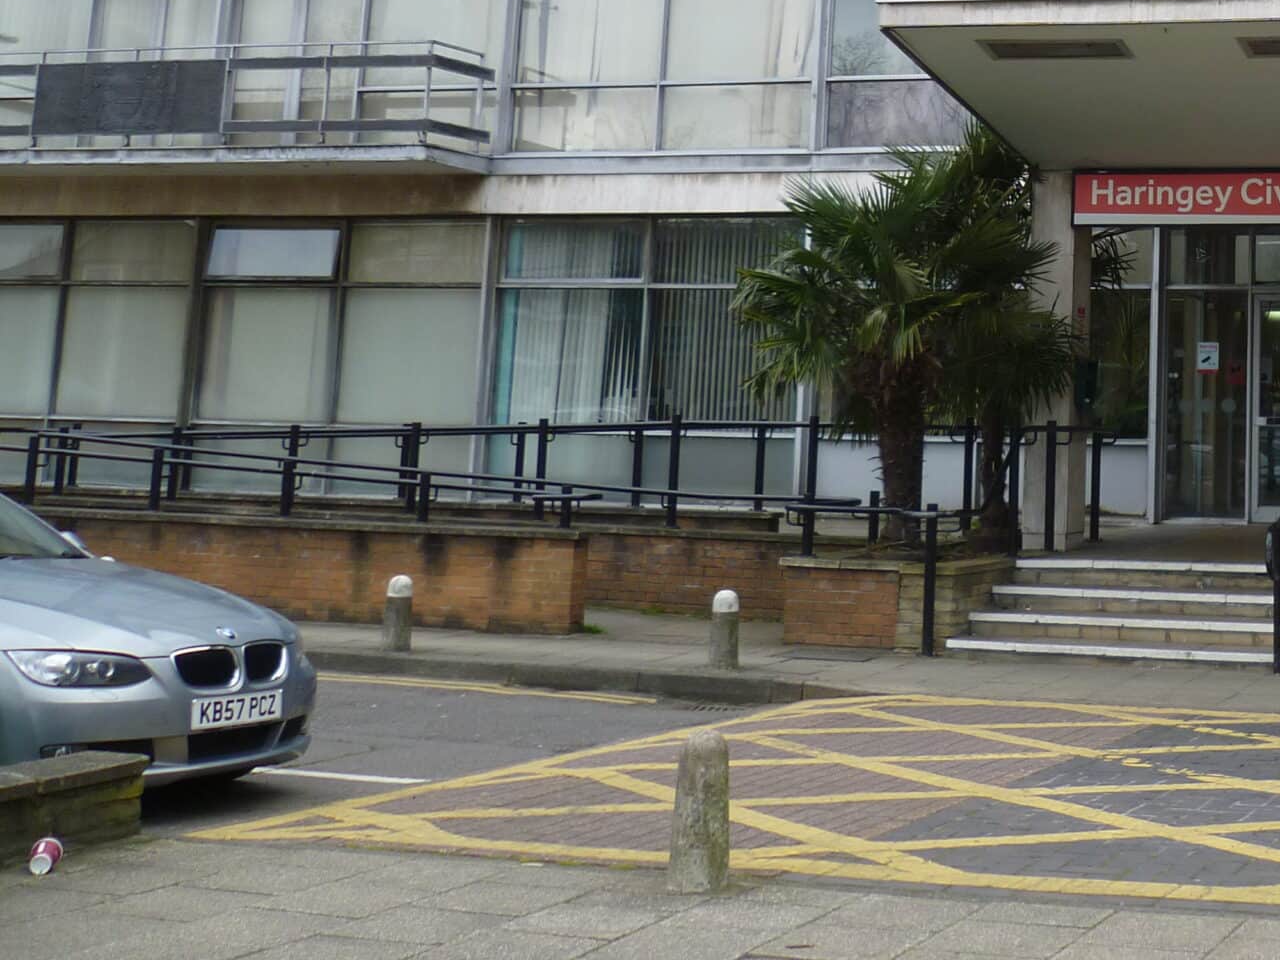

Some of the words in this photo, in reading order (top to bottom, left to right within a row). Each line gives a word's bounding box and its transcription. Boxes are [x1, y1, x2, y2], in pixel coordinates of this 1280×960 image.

[1090, 178, 1233, 213] Haringey
[200, 698, 246, 724] KB57
[249, 694, 276, 719] PCZ
